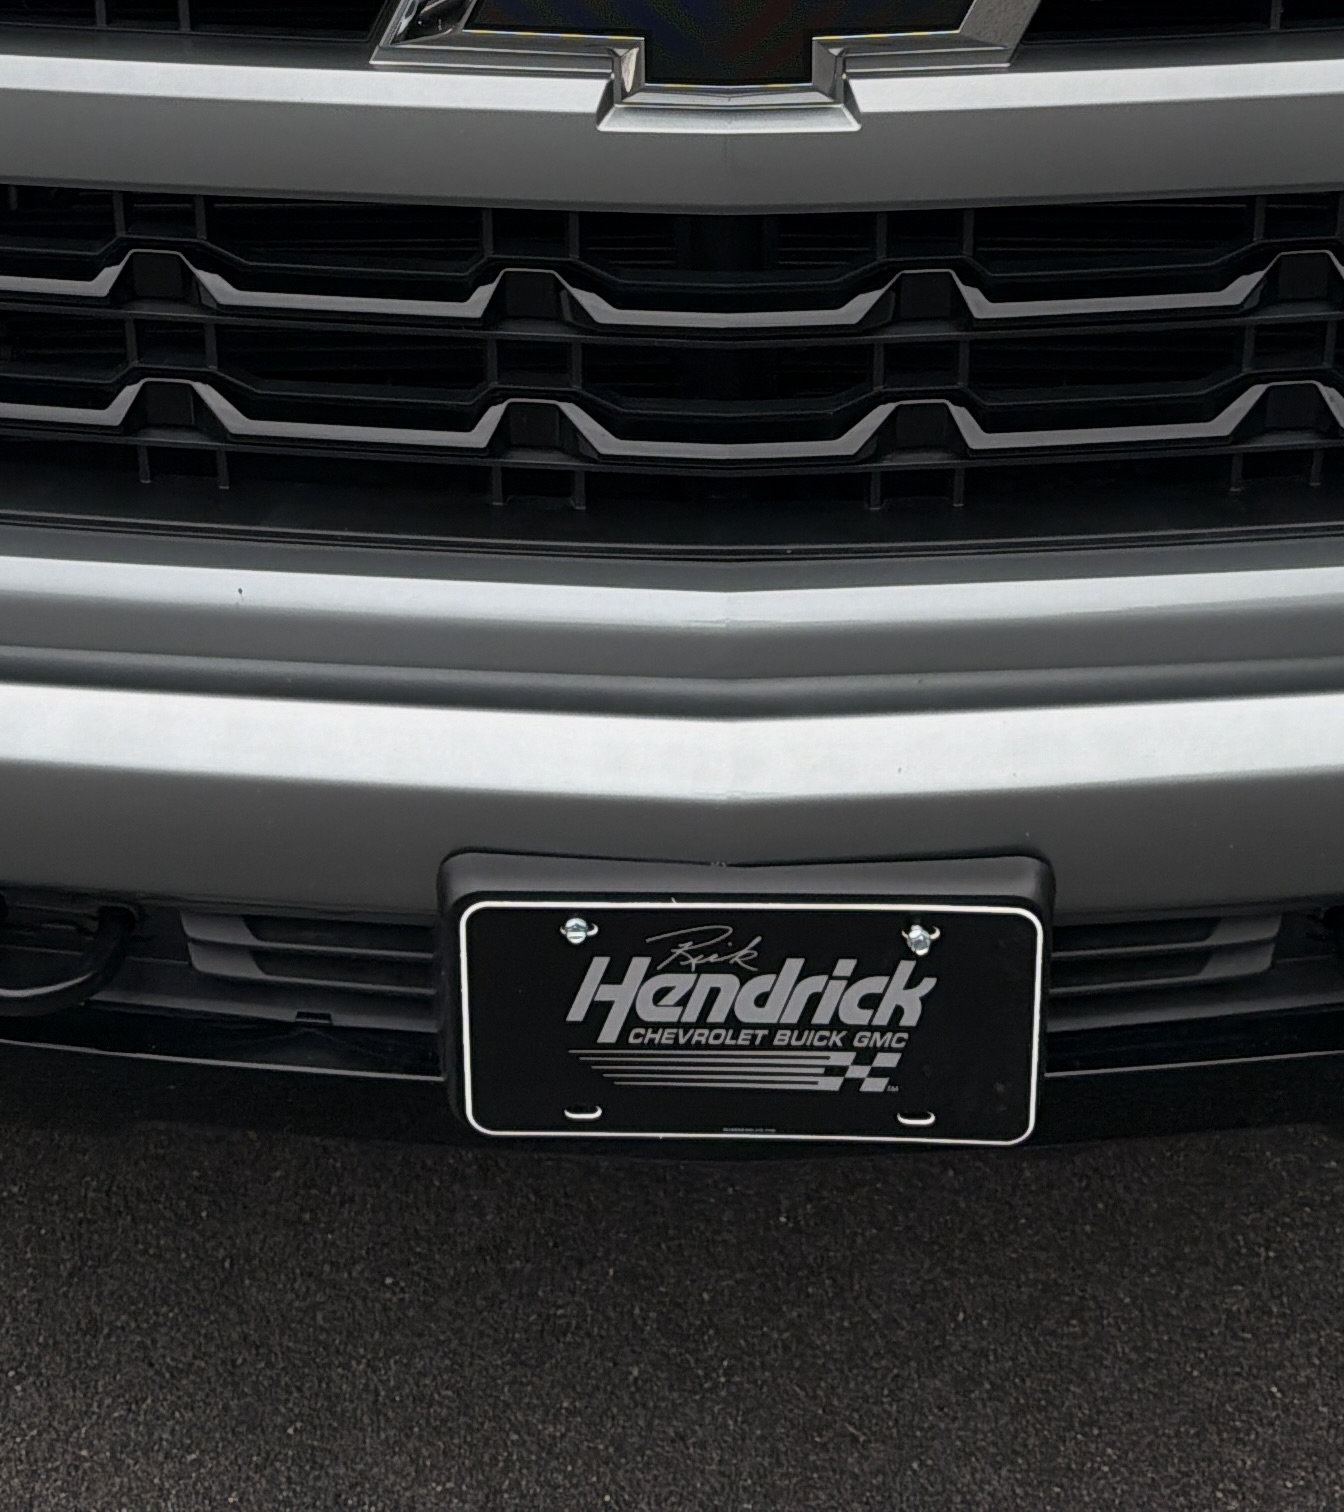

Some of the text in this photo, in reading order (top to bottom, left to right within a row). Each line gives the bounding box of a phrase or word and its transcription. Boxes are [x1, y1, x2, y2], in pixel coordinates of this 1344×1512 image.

[566, 956, 937, 1044] Hendrick
[628, 1027, 909, 1049] CHEVROLET BUICK GMC
